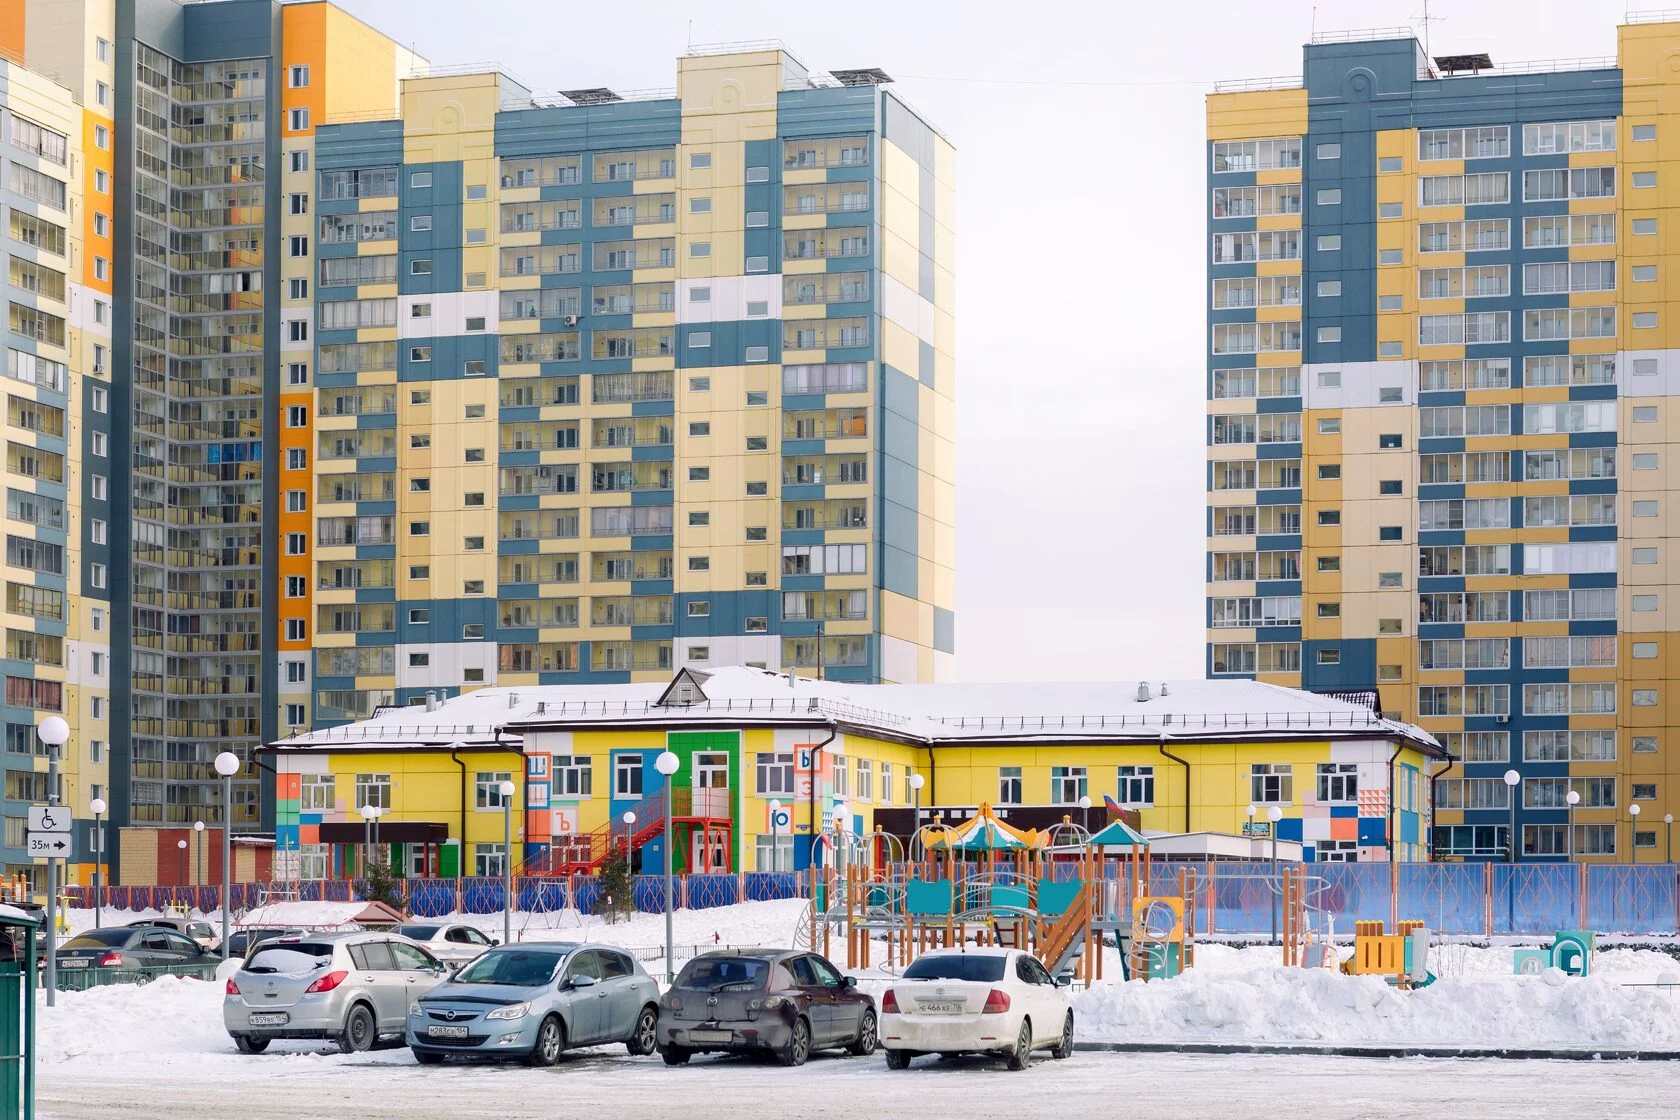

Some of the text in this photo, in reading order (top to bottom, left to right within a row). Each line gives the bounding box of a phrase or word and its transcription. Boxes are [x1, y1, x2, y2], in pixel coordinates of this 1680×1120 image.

[555, 812, 570, 831] Ъ
[771, 812, 789, 827] Ю
[31, 840, 50, 850] 35м
